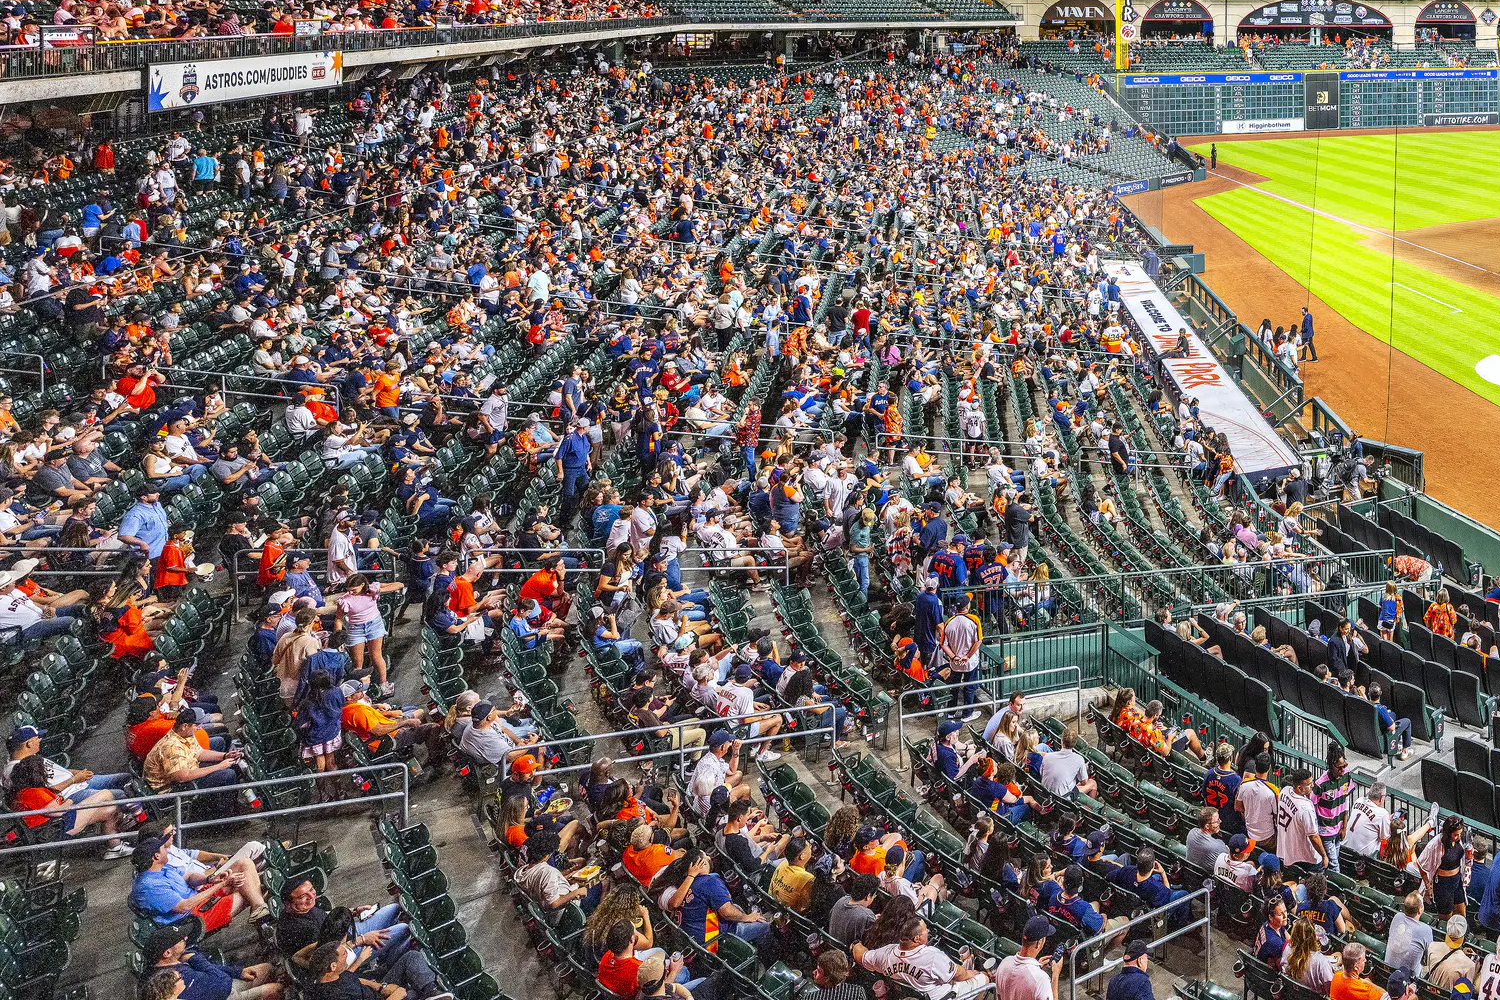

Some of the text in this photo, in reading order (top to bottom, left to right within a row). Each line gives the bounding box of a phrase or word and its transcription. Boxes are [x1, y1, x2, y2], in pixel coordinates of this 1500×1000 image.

[1056, 6, 1104, 18] MAVEN
[204, 65, 308, 91] ASTROS.COM/BUDDIES
[1435, 116, 1489, 125] NITTOTIRE.COM
[1172, 363, 1224, 388] PARK
[1206, 787, 1228, 808] 27
[1280, 793, 1298, 816] ALTUVE
[1278, 806, 1292, 832] 27
[1353, 802, 1376, 822] CORREA
[1350, 813, 1361, 833] 1
